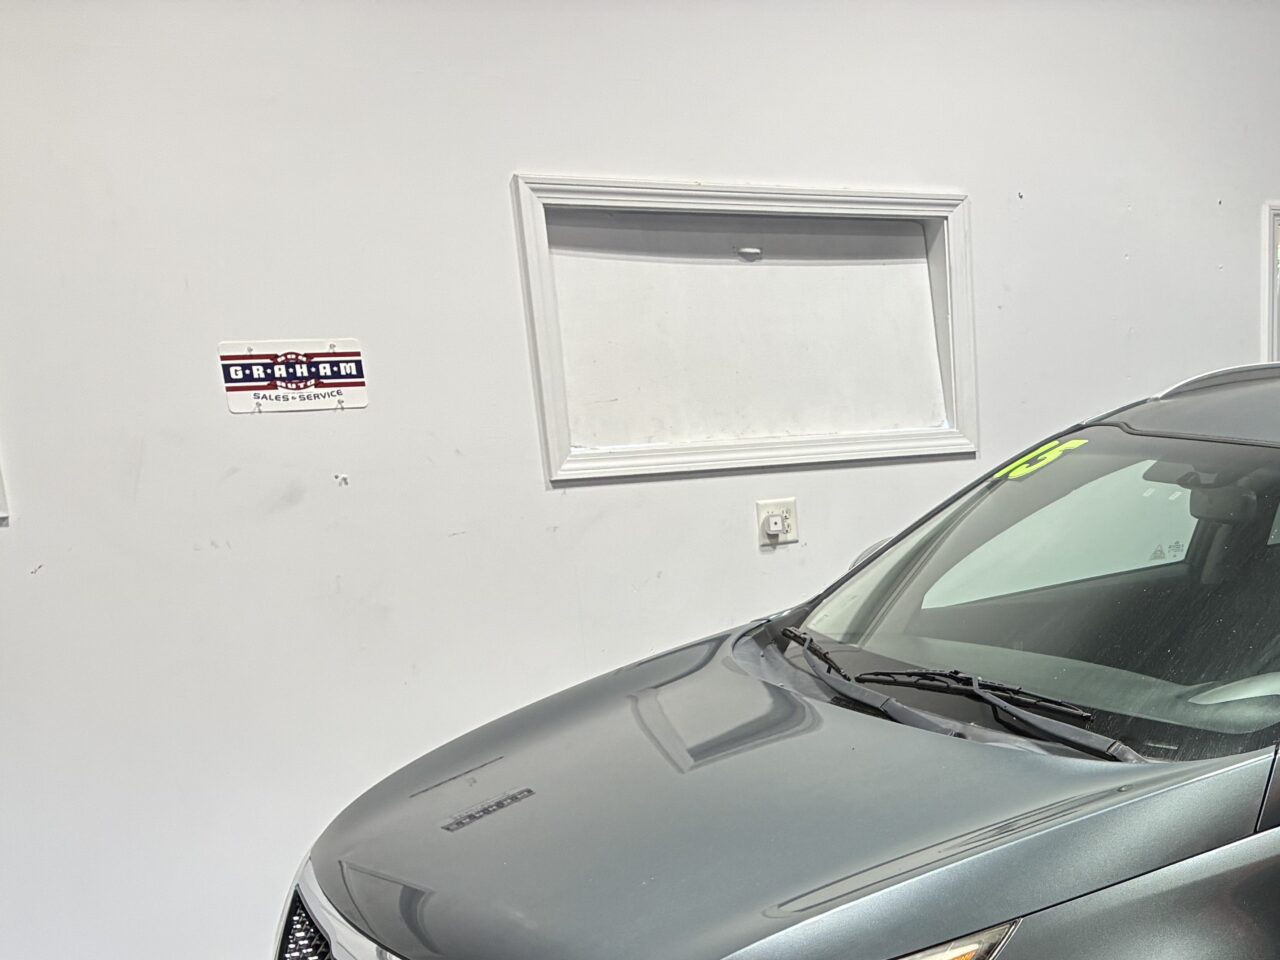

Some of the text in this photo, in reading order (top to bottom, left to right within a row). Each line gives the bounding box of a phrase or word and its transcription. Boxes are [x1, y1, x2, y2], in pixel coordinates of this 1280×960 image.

[229, 362, 357, 379] GRAHAM
[253, 392, 289, 401] SALES
[298, 389, 343, 401] SERVICE
